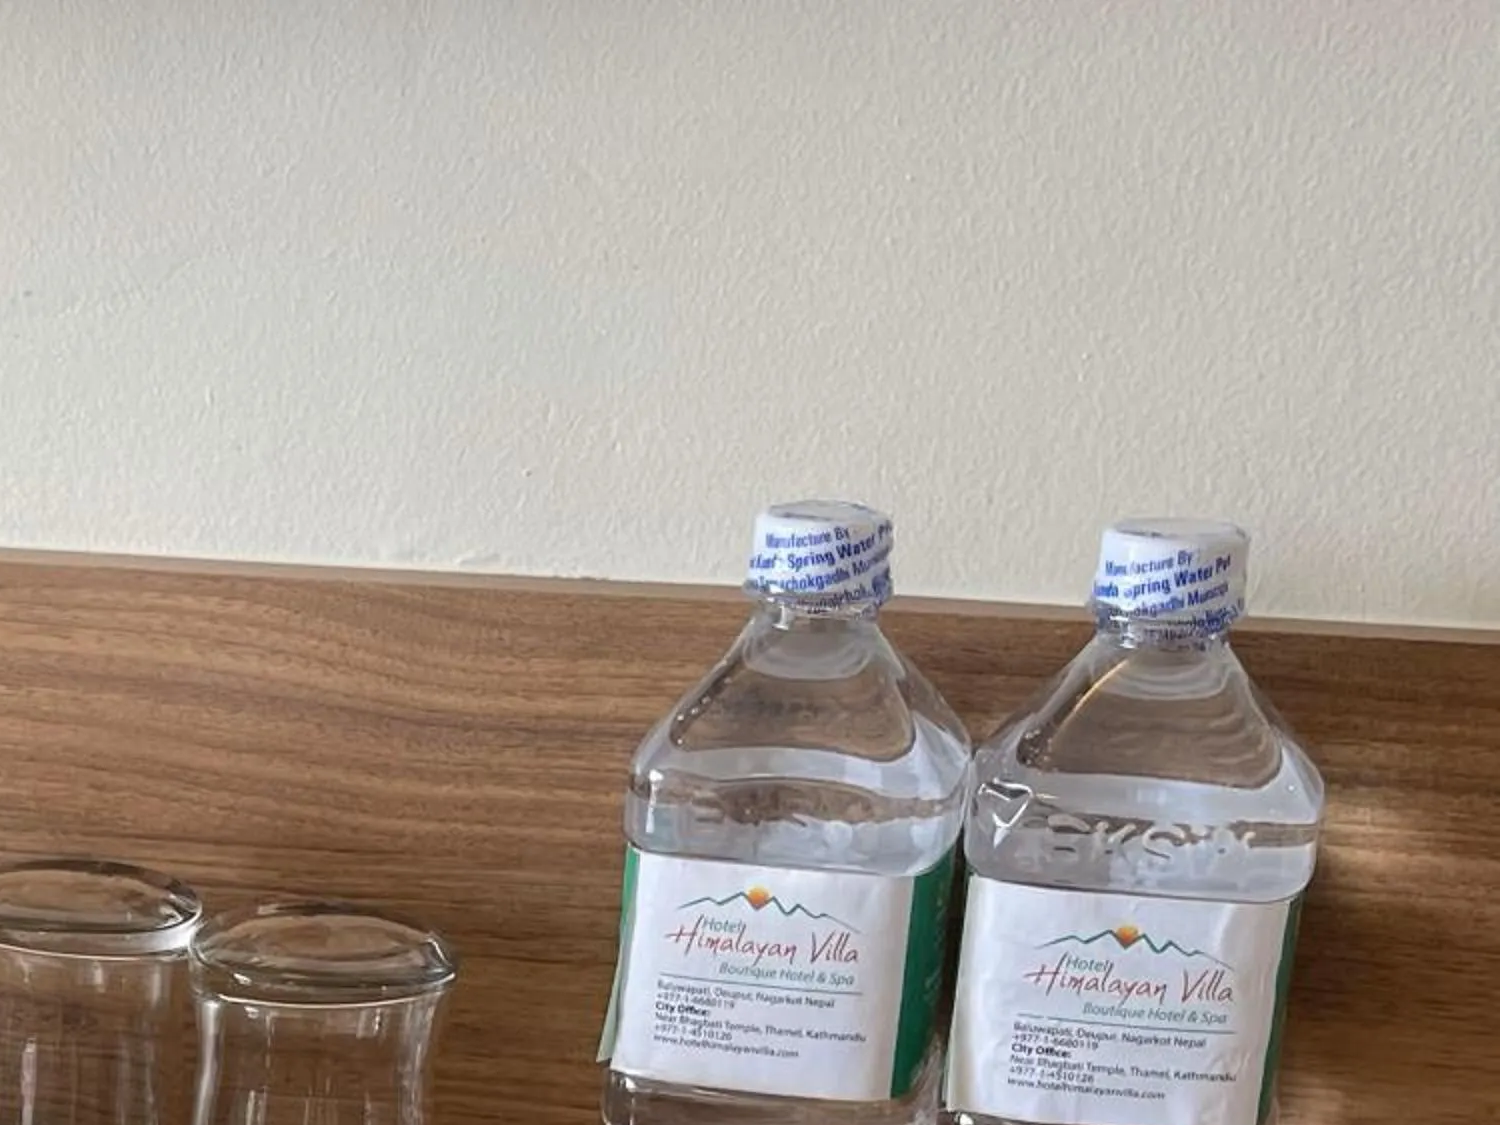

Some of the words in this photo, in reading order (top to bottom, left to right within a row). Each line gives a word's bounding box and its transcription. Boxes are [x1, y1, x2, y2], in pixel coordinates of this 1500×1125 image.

[787, 552, 835, 572] Spring
[836, 533, 876, 559] Water
[1174, 566, 1213, 588] Water
[702, 917, 744, 934] Hotel
[664, 914, 799, 967] Himalayan
[809, 931, 861, 964] Villa
[719, 961, 778, 981] Boutique
[779, 968, 815, 983] Hotel
[817, 971, 827, 984] &
[829, 971, 855, 986] Spa
[1065, 955, 1109, 971] Hotel
[1024, 951, 1167, 1005] Himalayan
[1181, 968, 1234, 1004] Villa
[655, 1001, 676, 1014] City
[1082, 1001, 1145, 1020] Boutique
[1148, 1007, 1186, 1022] Hotel
[1187, 1010, 1198, 1023] &
[1201, 1010, 1227, 1026] Spa
[1011, 1043, 1034, 1056] City
